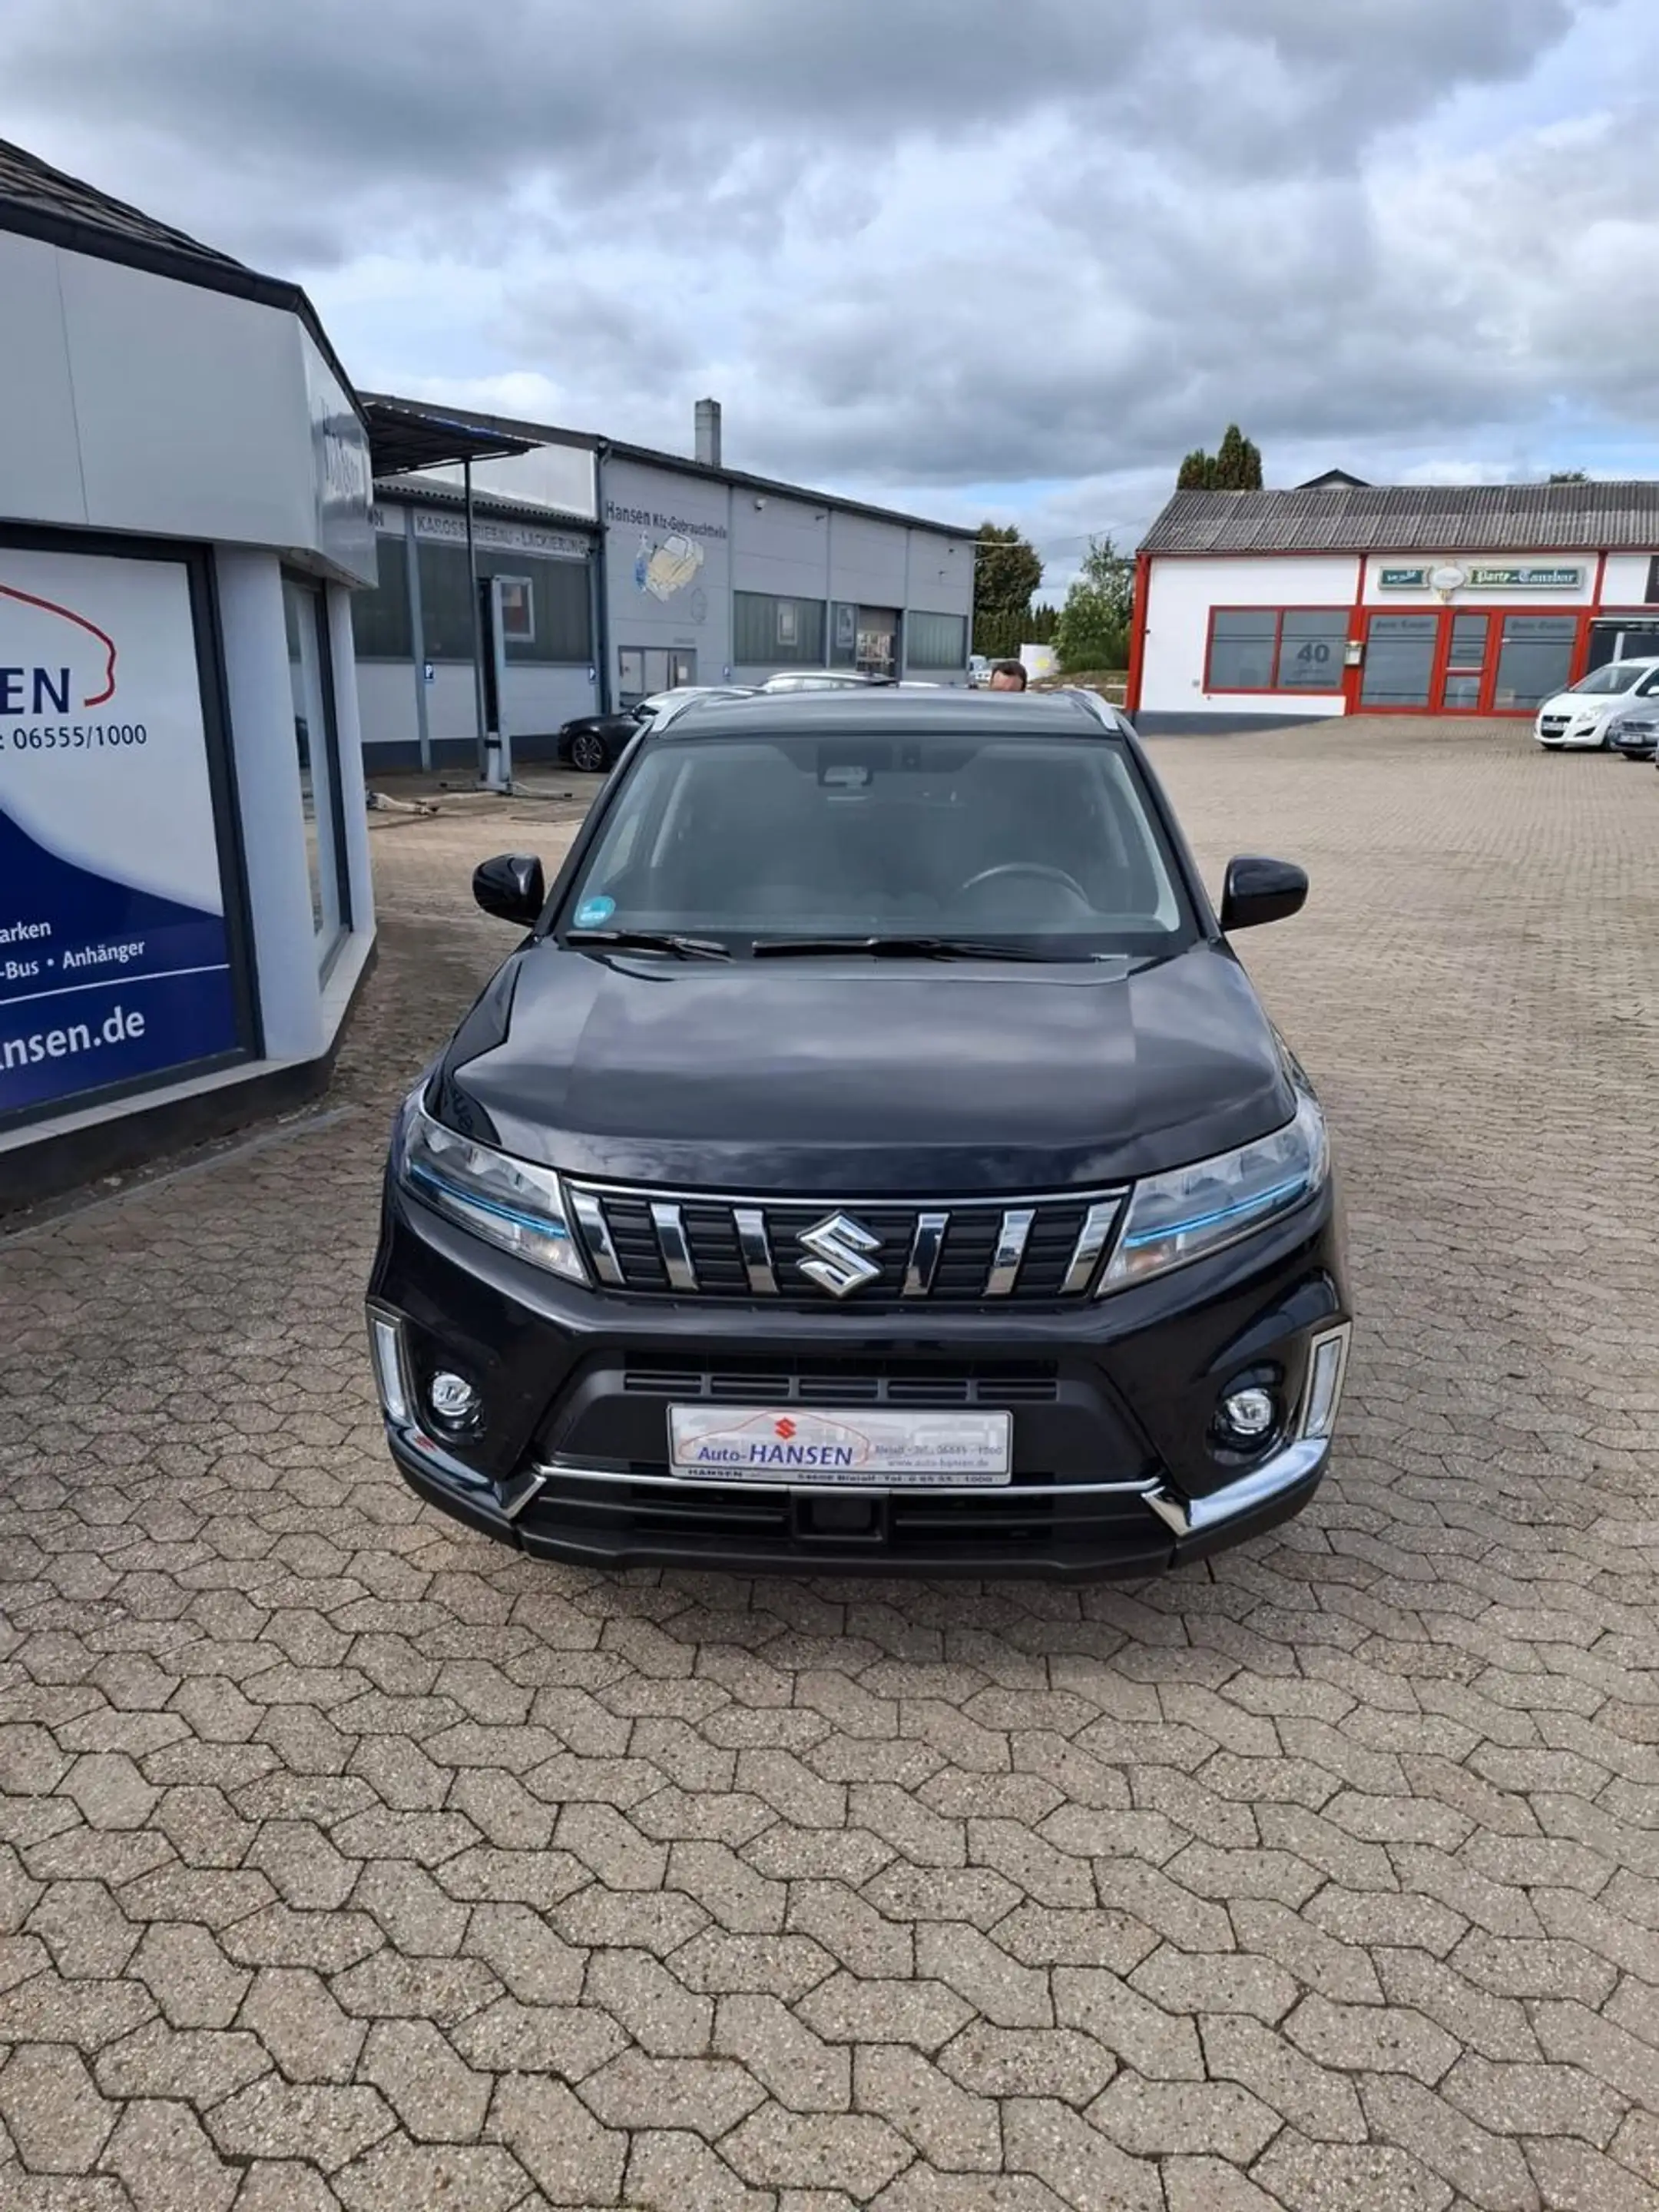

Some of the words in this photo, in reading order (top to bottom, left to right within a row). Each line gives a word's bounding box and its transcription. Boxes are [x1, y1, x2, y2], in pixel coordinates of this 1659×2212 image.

[606, 501, 651, 526] Hansen
[1296, 642, 1330, 663] 40
[13, 724, 147, 750] 06555/1000
[62, 941, 145, 970] Anhänger
[0, 1005, 145, 1071] nsen.de
[697, 1443, 853, 1466] Auto-HANSEN
